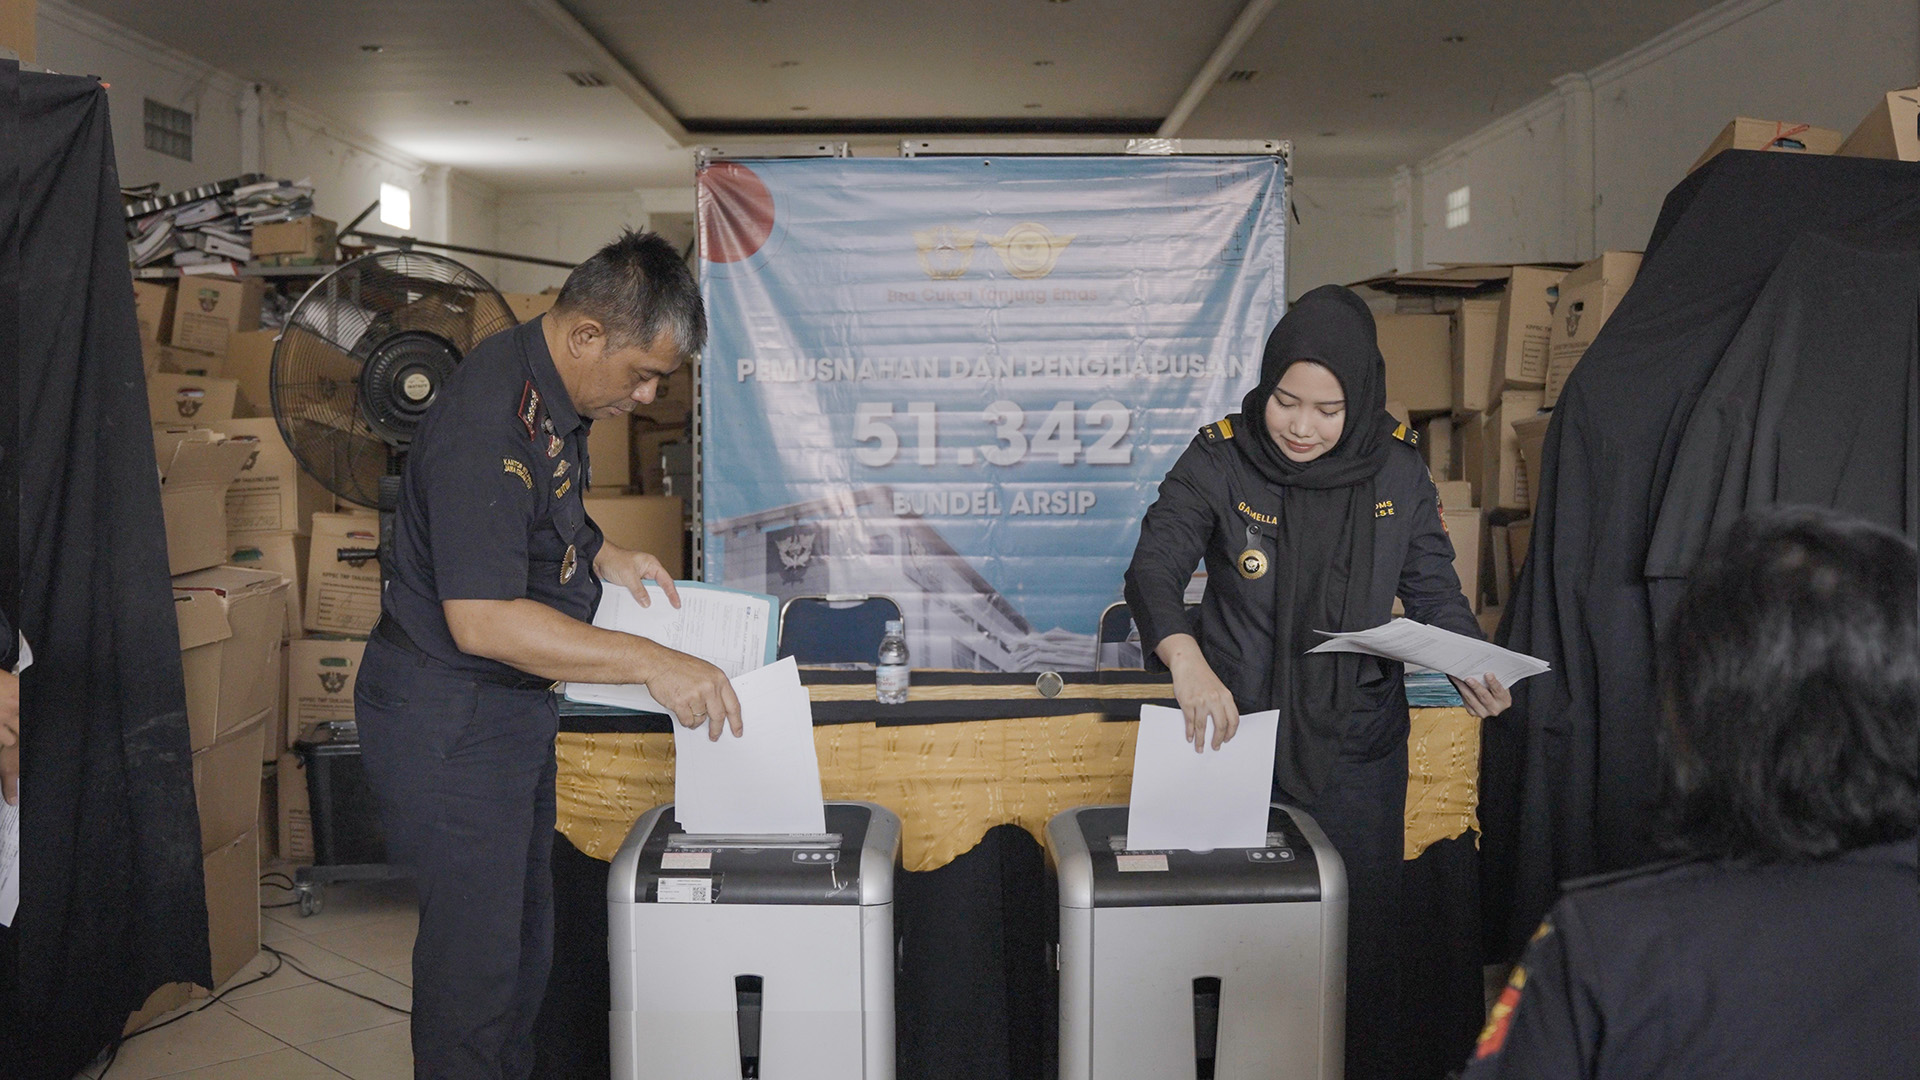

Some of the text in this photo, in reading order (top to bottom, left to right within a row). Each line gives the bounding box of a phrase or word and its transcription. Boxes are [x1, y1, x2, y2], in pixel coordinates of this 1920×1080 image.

[921, 287, 973, 302] Cukai
[978, 287, 1047, 305] Tanjung
[1052, 287, 1098, 302] Emas
[737, 353, 1250, 383] PEMUSNAHAN DAN PENGHAPUSAN
[851, 399, 1134, 467] 51.342
[892, 490, 1097, 516] BUNDEL ARSIP
